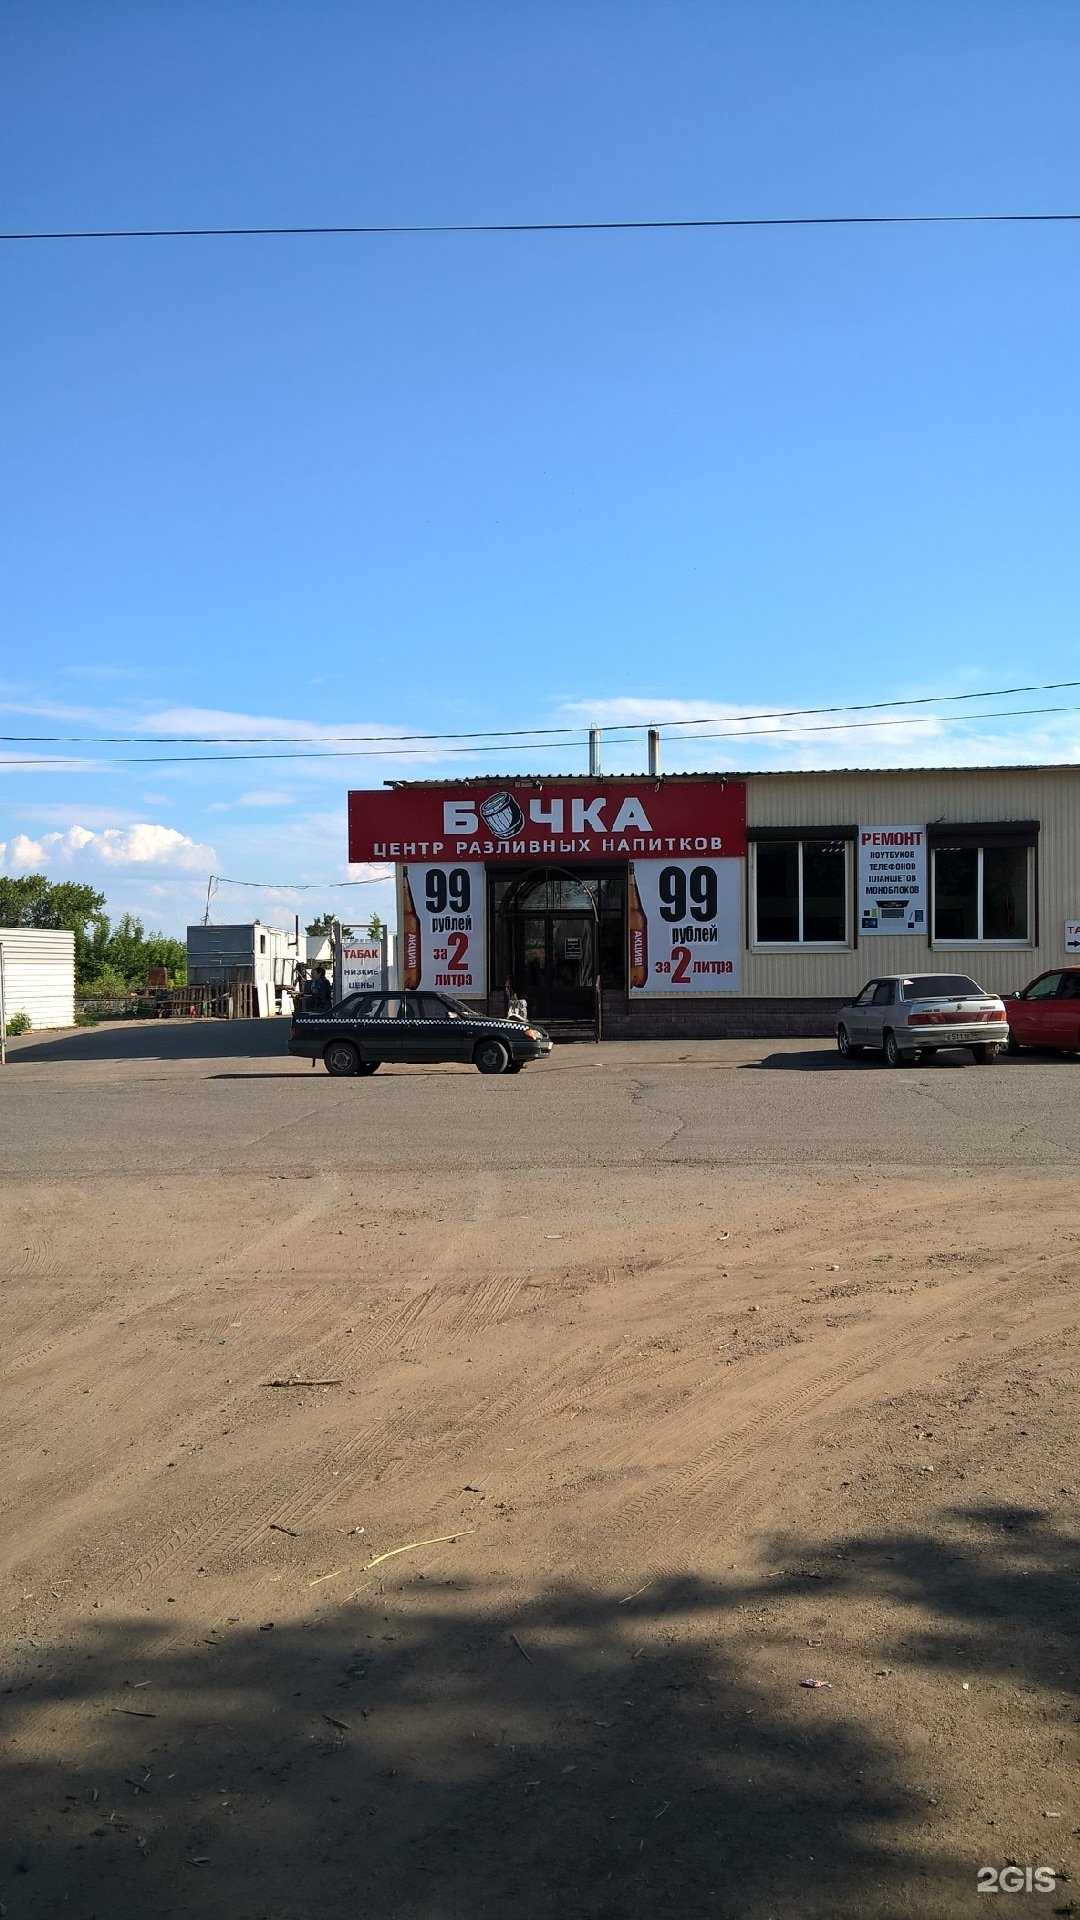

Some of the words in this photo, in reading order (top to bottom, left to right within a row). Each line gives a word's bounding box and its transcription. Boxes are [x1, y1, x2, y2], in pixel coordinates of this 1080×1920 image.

[373, 842, 444, 857] ЦЕНТР
[456, 839, 592, 854] РАЗЛИВНЫХ
[602, 837, 722, 851] НАПИТКОВ
[861, 831, 923, 846] РЕМОНТ
[425, 868, 470, 913] 99
[659, 865, 718, 922] 99
[865, 886, 920, 895] МОНОБЛОКОВ
[432, 915, 472, 932] рублей
[672, 924, 718, 944] рублей
[343, 949, 379, 959] ТАБАК
[433, 948, 448, 960] за
[447, 932, 469, 970] 2
[655, 961, 671, 973] за
[671, 946, 692, 984] 2
[693, 960, 733, 975] литра
[348, 981, 375, 989] ЦЕНЫ
[434, 974, 473, 987] литра
